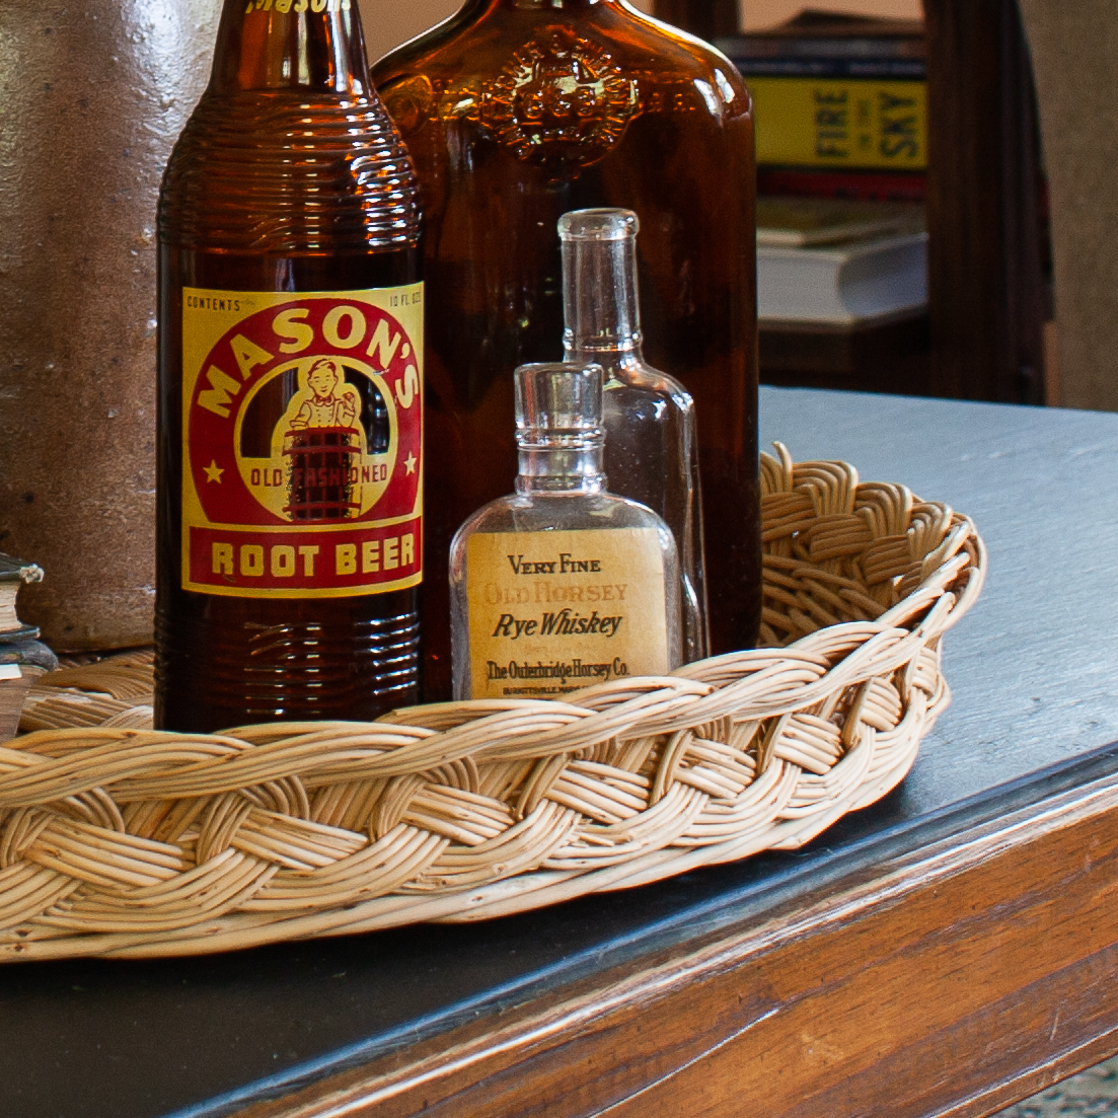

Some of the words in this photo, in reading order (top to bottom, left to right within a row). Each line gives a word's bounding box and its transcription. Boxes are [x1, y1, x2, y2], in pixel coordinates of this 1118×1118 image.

[815, 90, 848, 157] FIRE
[880, 92, 918, 158] SKY
[187, 295, 241, 311] CONTENTS
[196, 305, 420, 419] MASON'S
[250, 467, 283, 487] OLD
[293, 463, 388, 488] FASHIONED
[211, 541, 320, 578] ROOT
[335, 533, 416, 575] BEER
[534, 581, 628, 603] HORSEY
[492, 614, 537, 640] Rye
[540, 608, 622, 637] Whiskey
[487, 660, 507, 679] The
[572, 658, 612, 680] Horsey
[613, 657, 630, 675] Co.
